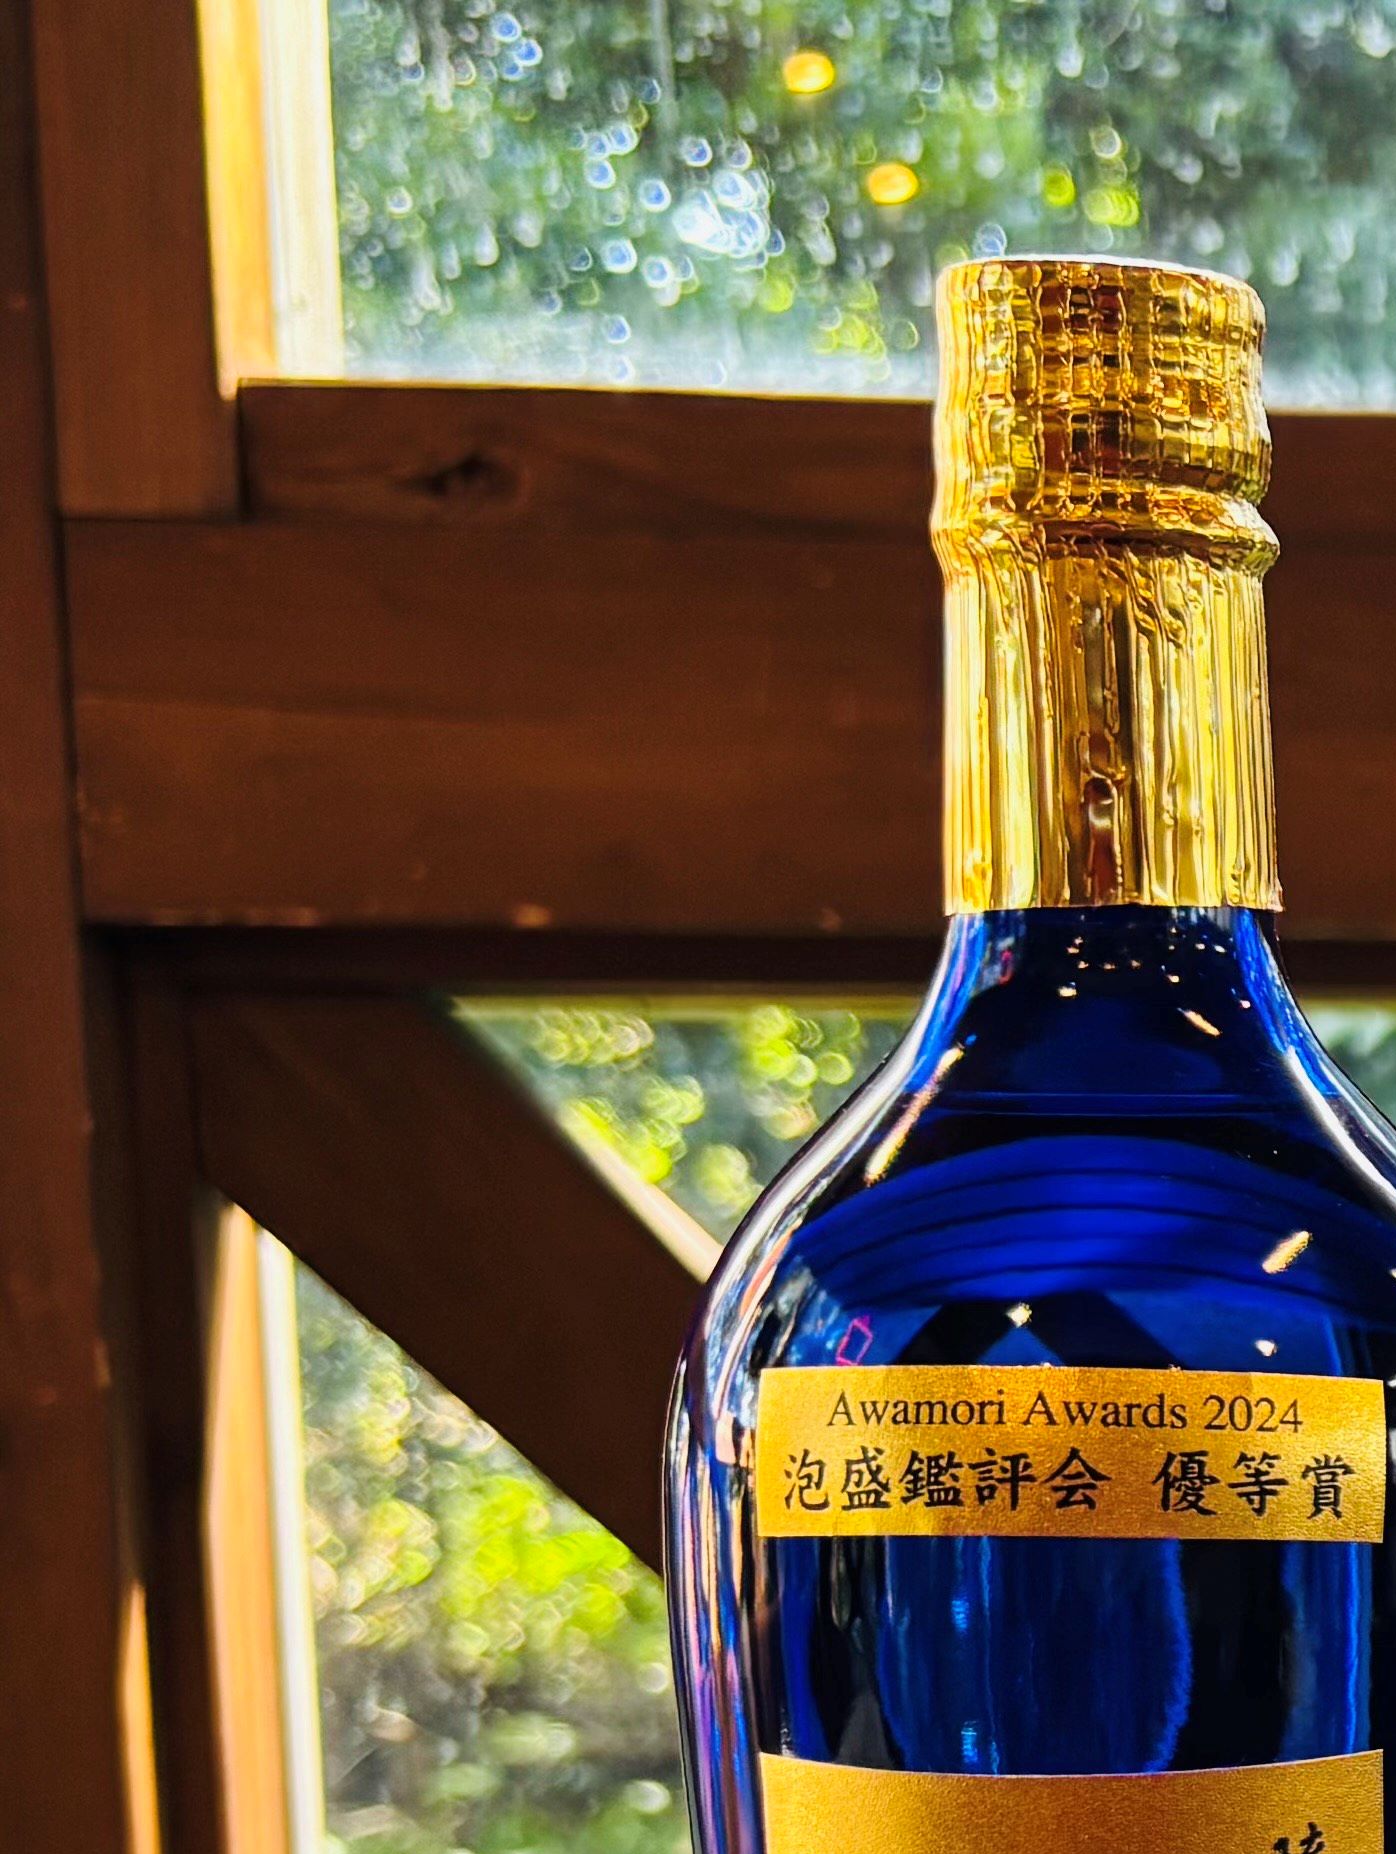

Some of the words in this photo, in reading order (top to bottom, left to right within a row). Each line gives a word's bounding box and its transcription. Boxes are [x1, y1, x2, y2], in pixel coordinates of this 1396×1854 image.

[827, 1389, 1005, 1427] Awamori
[1021, 1390, 1188, 1430] Awards
[1203, 1394, 1304, 1433] 2024
[783, 1445, 1113, 1513] 泡盛鑑評会
[1151, 1449, 1357, 1521] 優等賞
